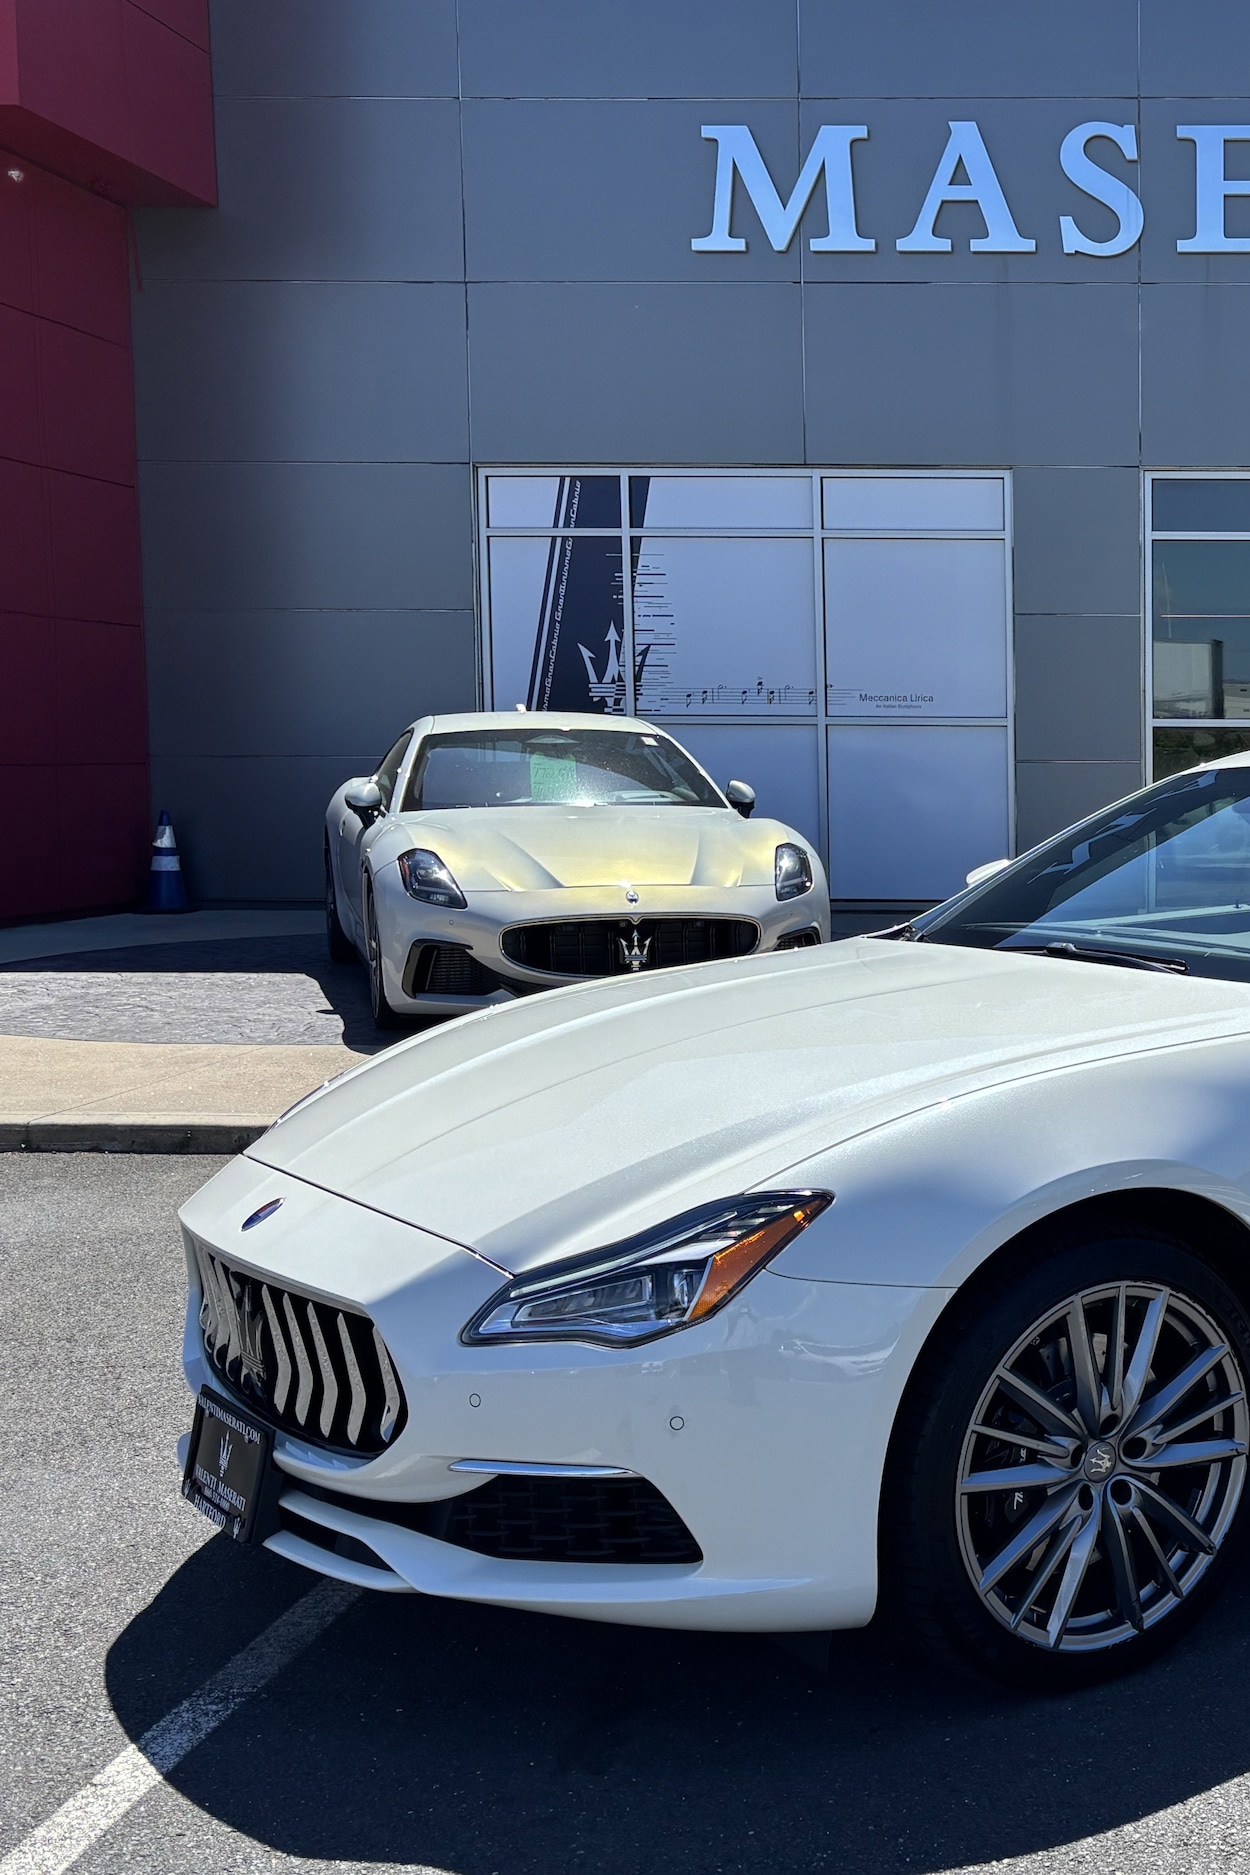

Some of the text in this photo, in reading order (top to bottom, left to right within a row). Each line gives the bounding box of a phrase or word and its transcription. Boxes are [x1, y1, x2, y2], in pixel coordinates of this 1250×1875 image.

[859, 693, 934, 702] Meccanica Lirica
[195, 1463, 217, 1489] VALENTI
[217, 1479, 247, 1512] MASERATI
[194, 1493, 226, 1529] HARTFORD
